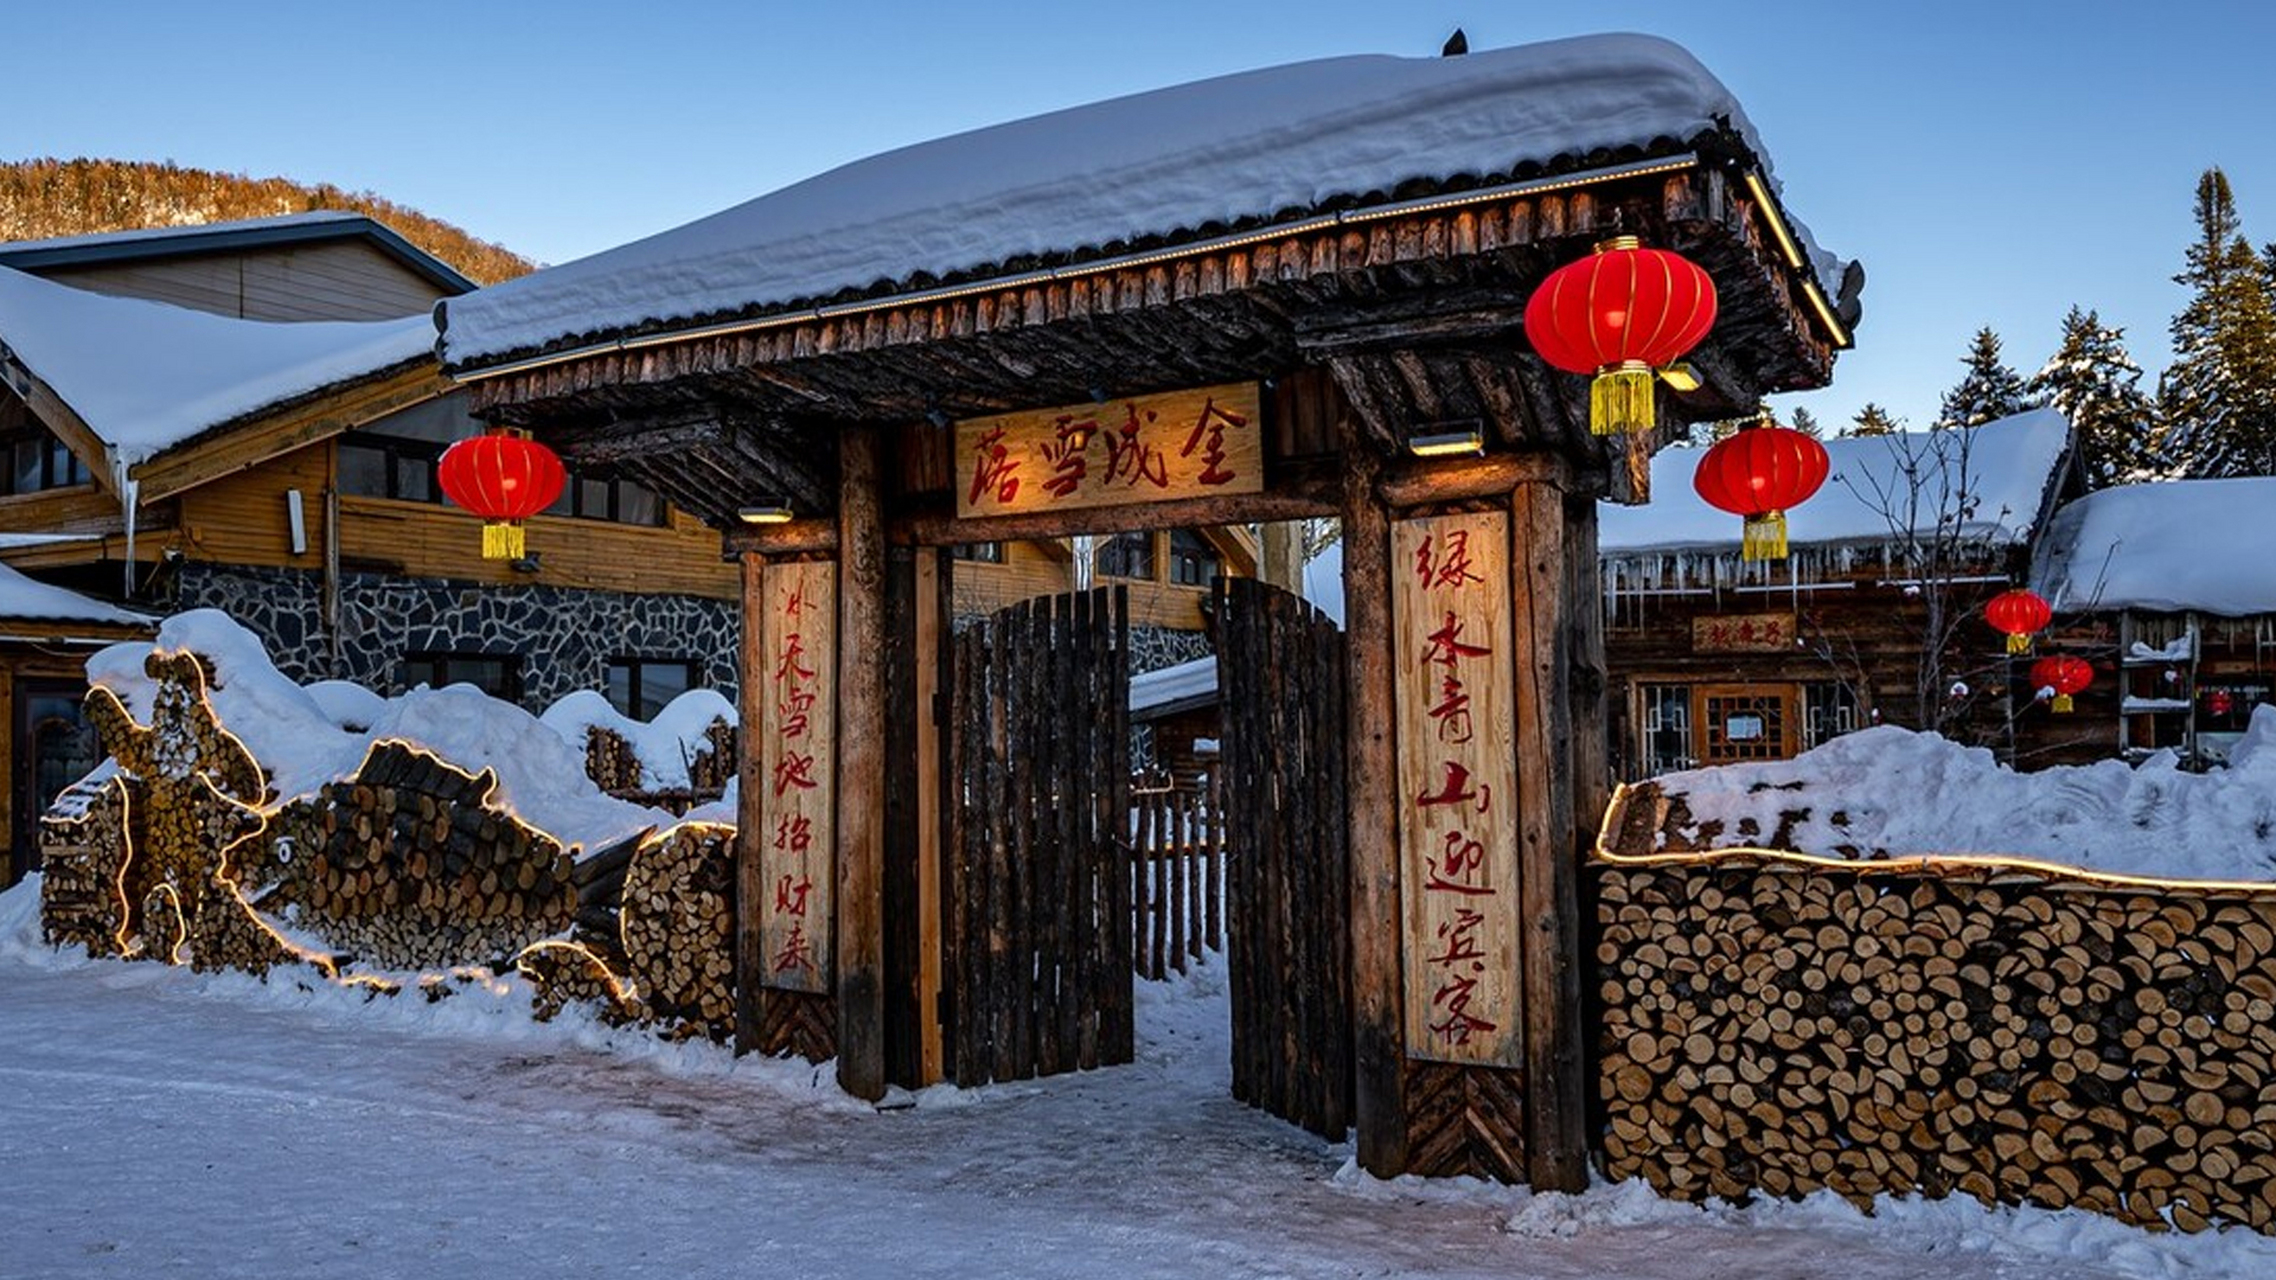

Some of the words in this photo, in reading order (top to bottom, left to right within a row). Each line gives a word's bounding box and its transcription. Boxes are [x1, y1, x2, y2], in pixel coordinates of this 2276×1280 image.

[1415, 530, 1497, 1046] 绿水青山迎宾客
